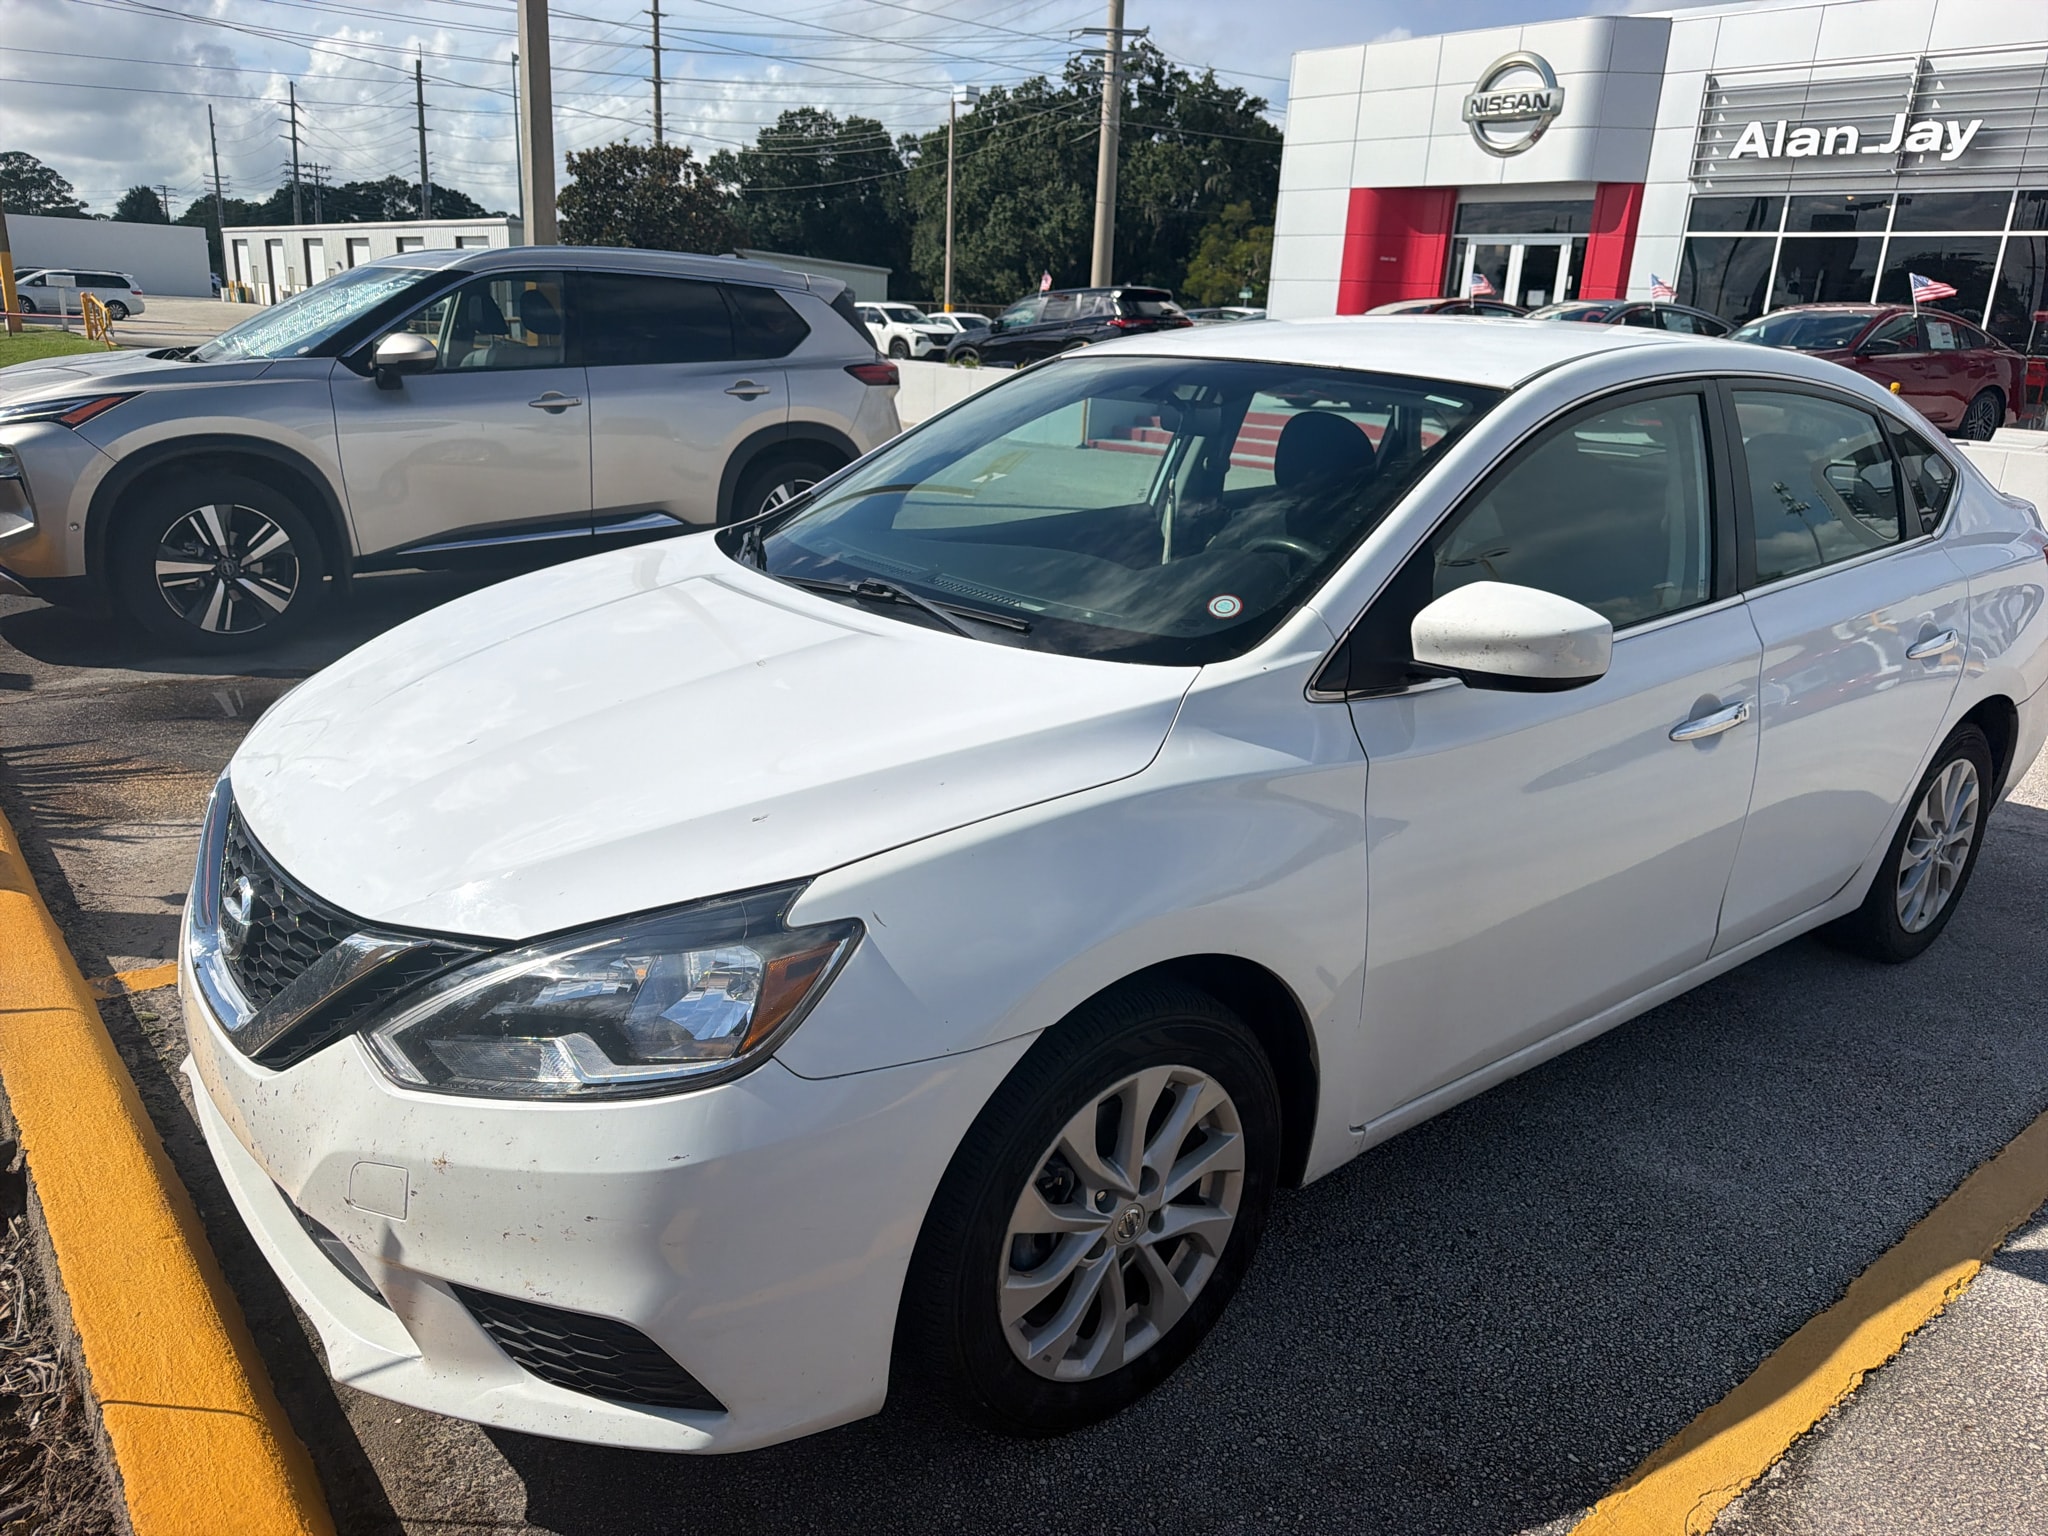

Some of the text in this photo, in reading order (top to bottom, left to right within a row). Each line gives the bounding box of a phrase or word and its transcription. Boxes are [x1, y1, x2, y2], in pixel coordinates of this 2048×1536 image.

[1470, 93, 1551, 114] NISSAN
[1728, 112, 1984, 161] Alan Jay
